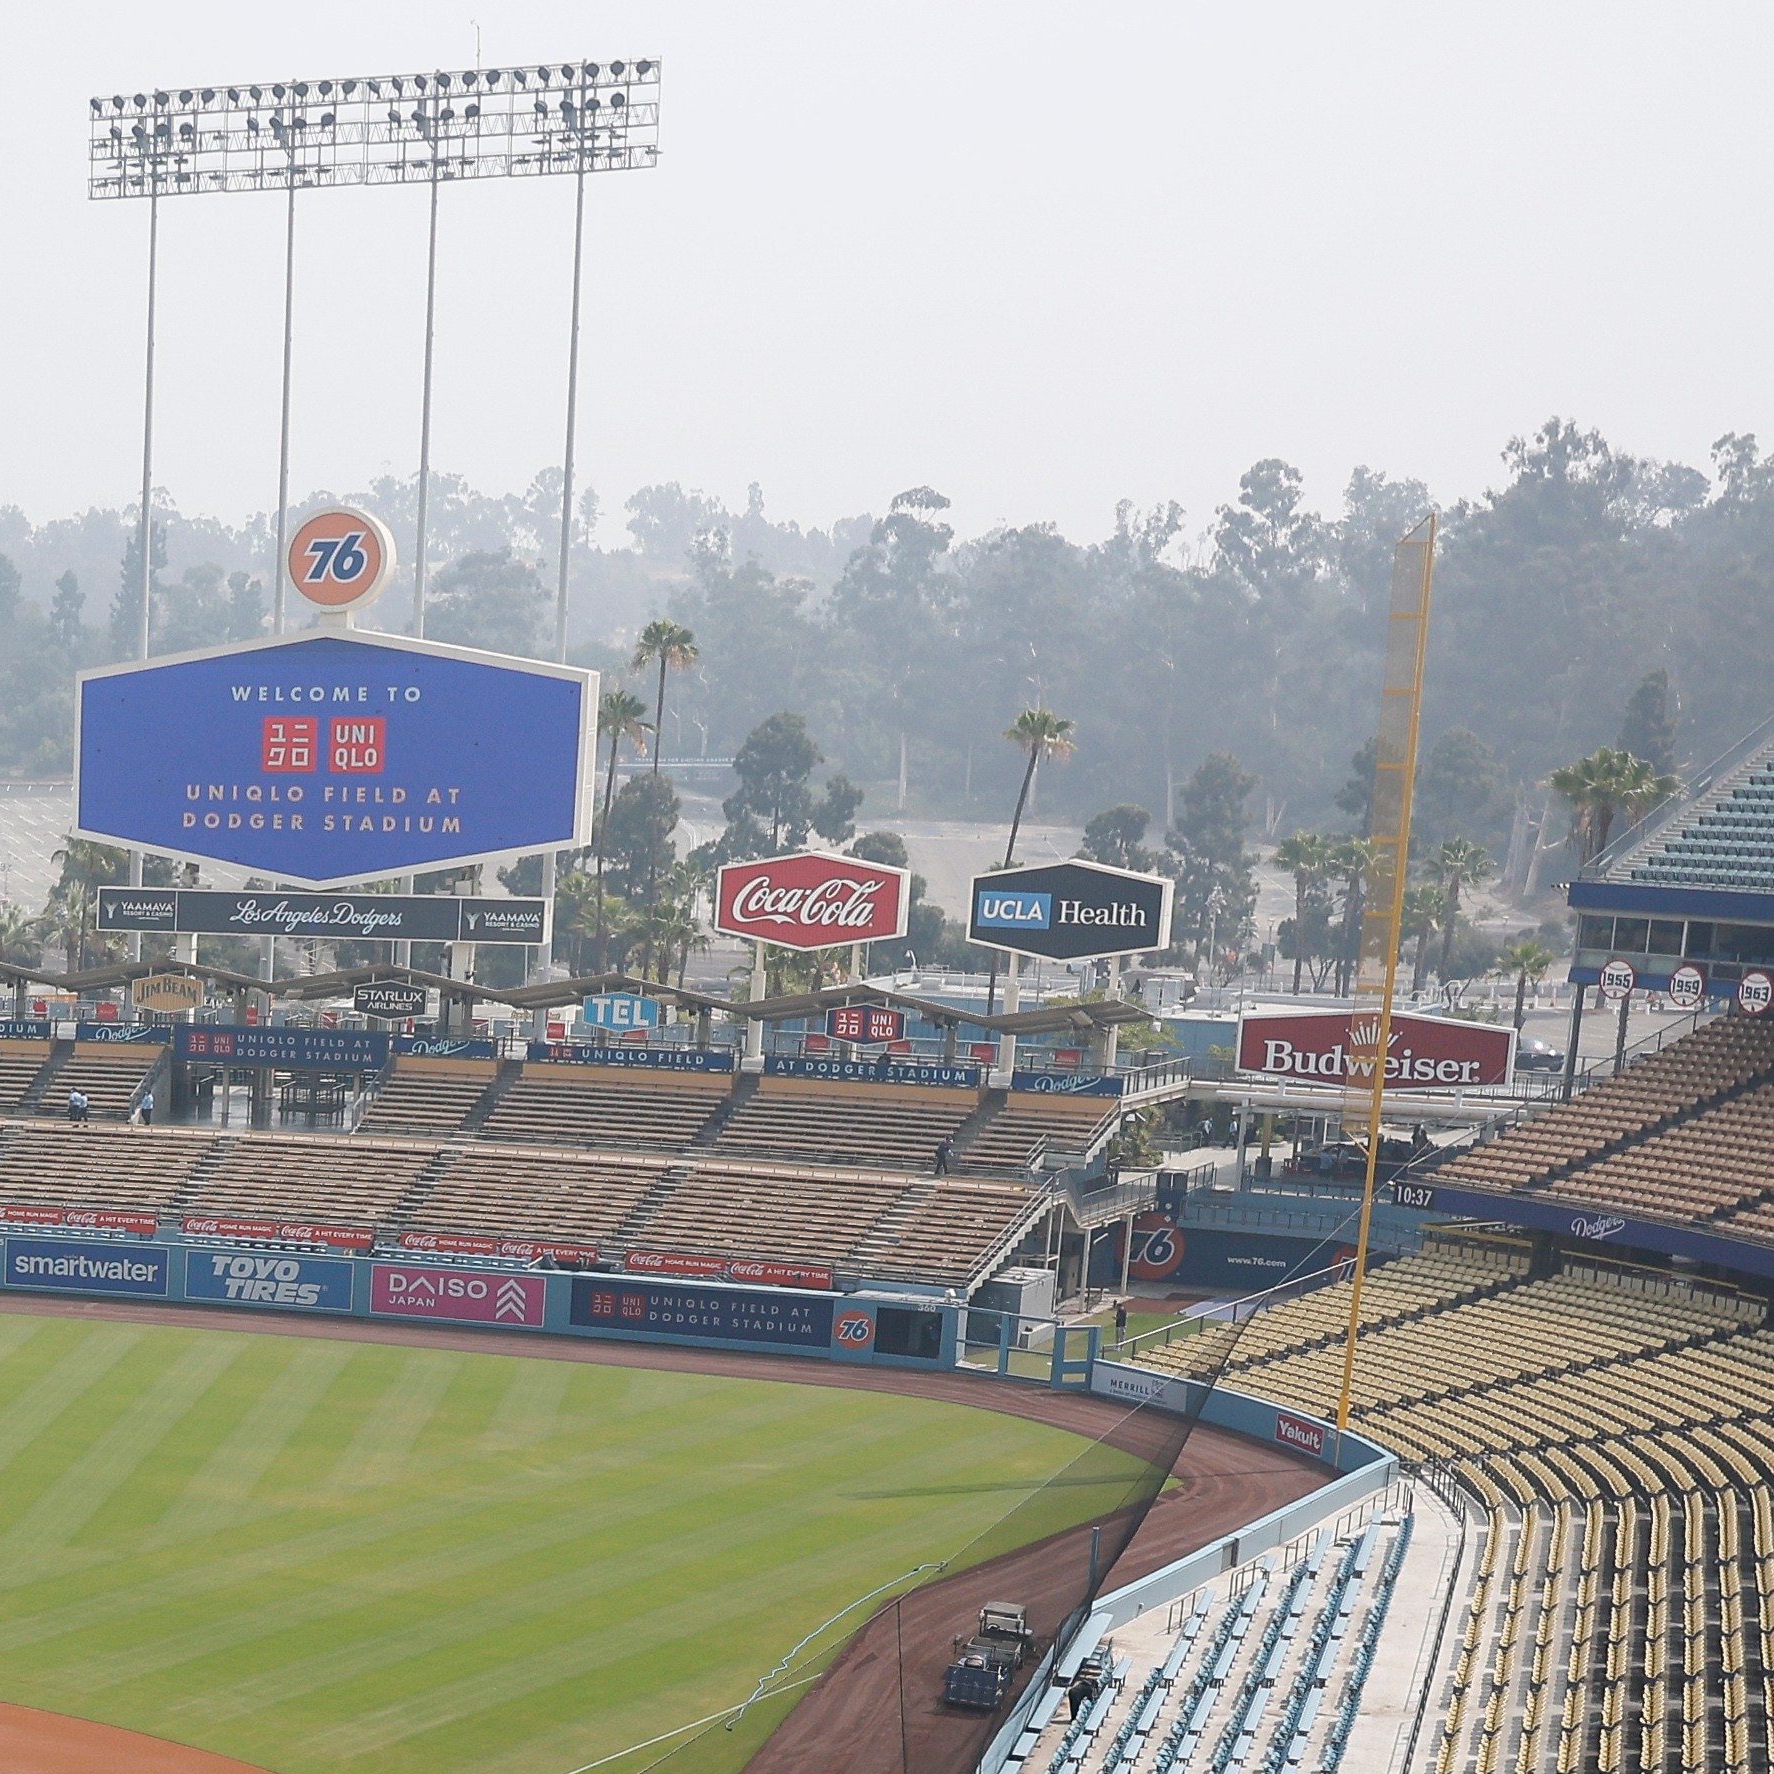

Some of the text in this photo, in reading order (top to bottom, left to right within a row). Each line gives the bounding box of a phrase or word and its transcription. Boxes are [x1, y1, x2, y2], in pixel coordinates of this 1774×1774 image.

[303, 531, 368, 584] 76
[231, 685, 422, 703] WELCOME TO
[335, 724, 375, 744] UNI
[334, 747, 378, 770] QLO
[186, 784, 460, 805] UNIQLO FIELD AT
[182, 812, 462, 833] DODGER STADIUM
[732, 875, 886, 928] Coca-Cola
[229, 900, 403, 934] Los Angeles Dodgers
[983, 898, 1147, 927] UCLA Health
[1602, 971, 1631, 987] 1955
[1672, 978, 1700, 995] 1959
[137, 977, 197, 1003] JIM BEAM
[357, 990, 422, 1002] STARLUX
[1740, 985, 1769, 1002] 1963
[367, 1002, 413, 1011] AIRLINES
[592, 998, 650, 1026] TEL
[871, 1014, 892, 1026] UNI
[871, 1026, 893, 1038] QLO
[582, 1048, 705, 1065] UNIQLO FIELD
[1261, 1039, 1480, 1084] Budweiser
[777, 1060, 967, 1082] AT DODGER STADIUM
[1397, 1186, 1433, 1207] 10:37
[1129, 1228, 1176, 1266] 76
[15, 1254, 158, 1282] smartwater
[210, 1255, 300, 1281] TOYO
[1227, 1256, 1286, 1268] www.76.com
[224, 1278, 322, 1306] TIRES
[389, 1273, 488, 1299] DAISO
[388, 1295, 456, 1308] JAPAN
[838, 1319, 869, 1341] 76
[1110, 1378, 1151, 1395] MERRILL
[1278, 1421, 1320, 1450] Yakult
